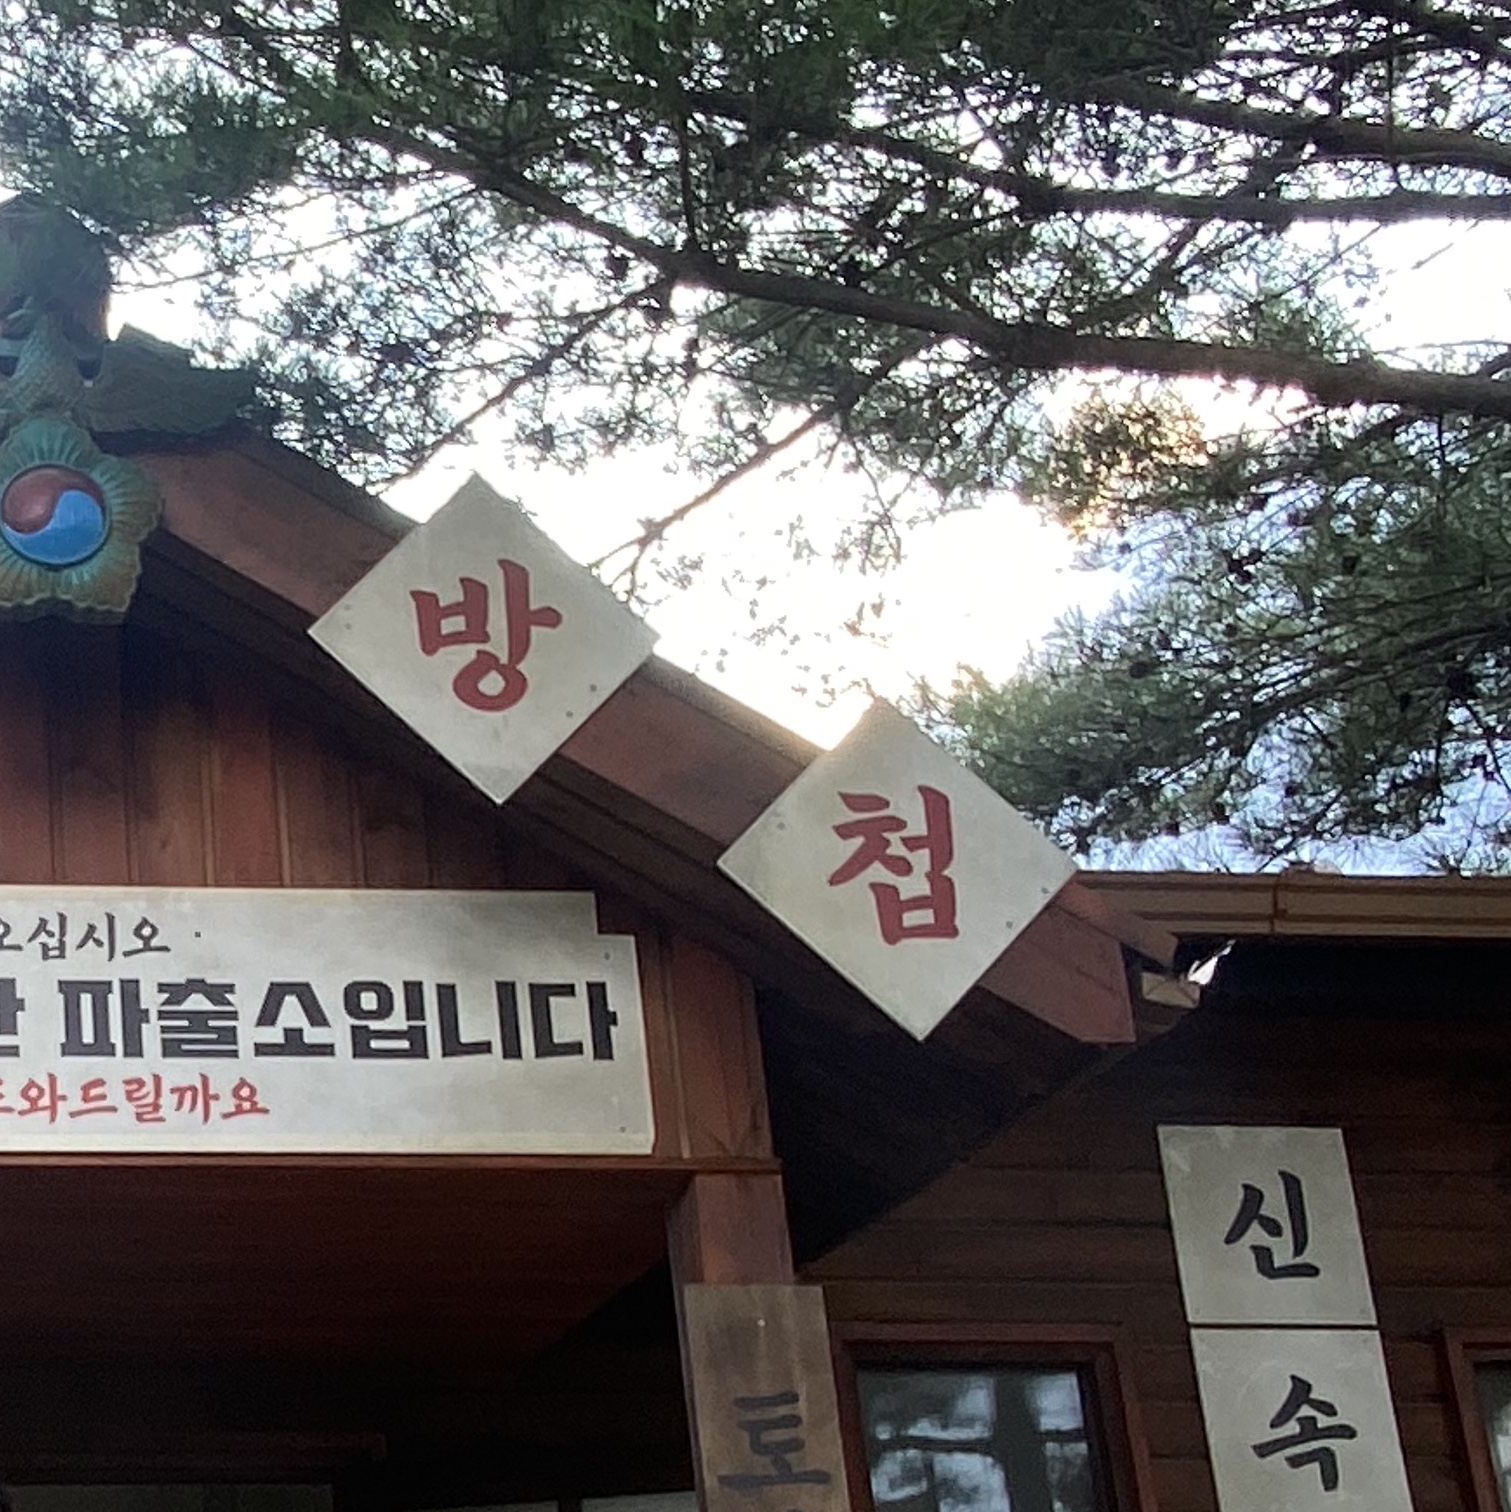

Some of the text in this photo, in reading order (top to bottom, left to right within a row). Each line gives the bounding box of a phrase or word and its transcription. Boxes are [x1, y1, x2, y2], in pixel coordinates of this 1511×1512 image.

[410, 559, 563, 711] 방
[828, 785, 960, 946] 첩
[57, 978, 619, 1062] 파출소입니다
